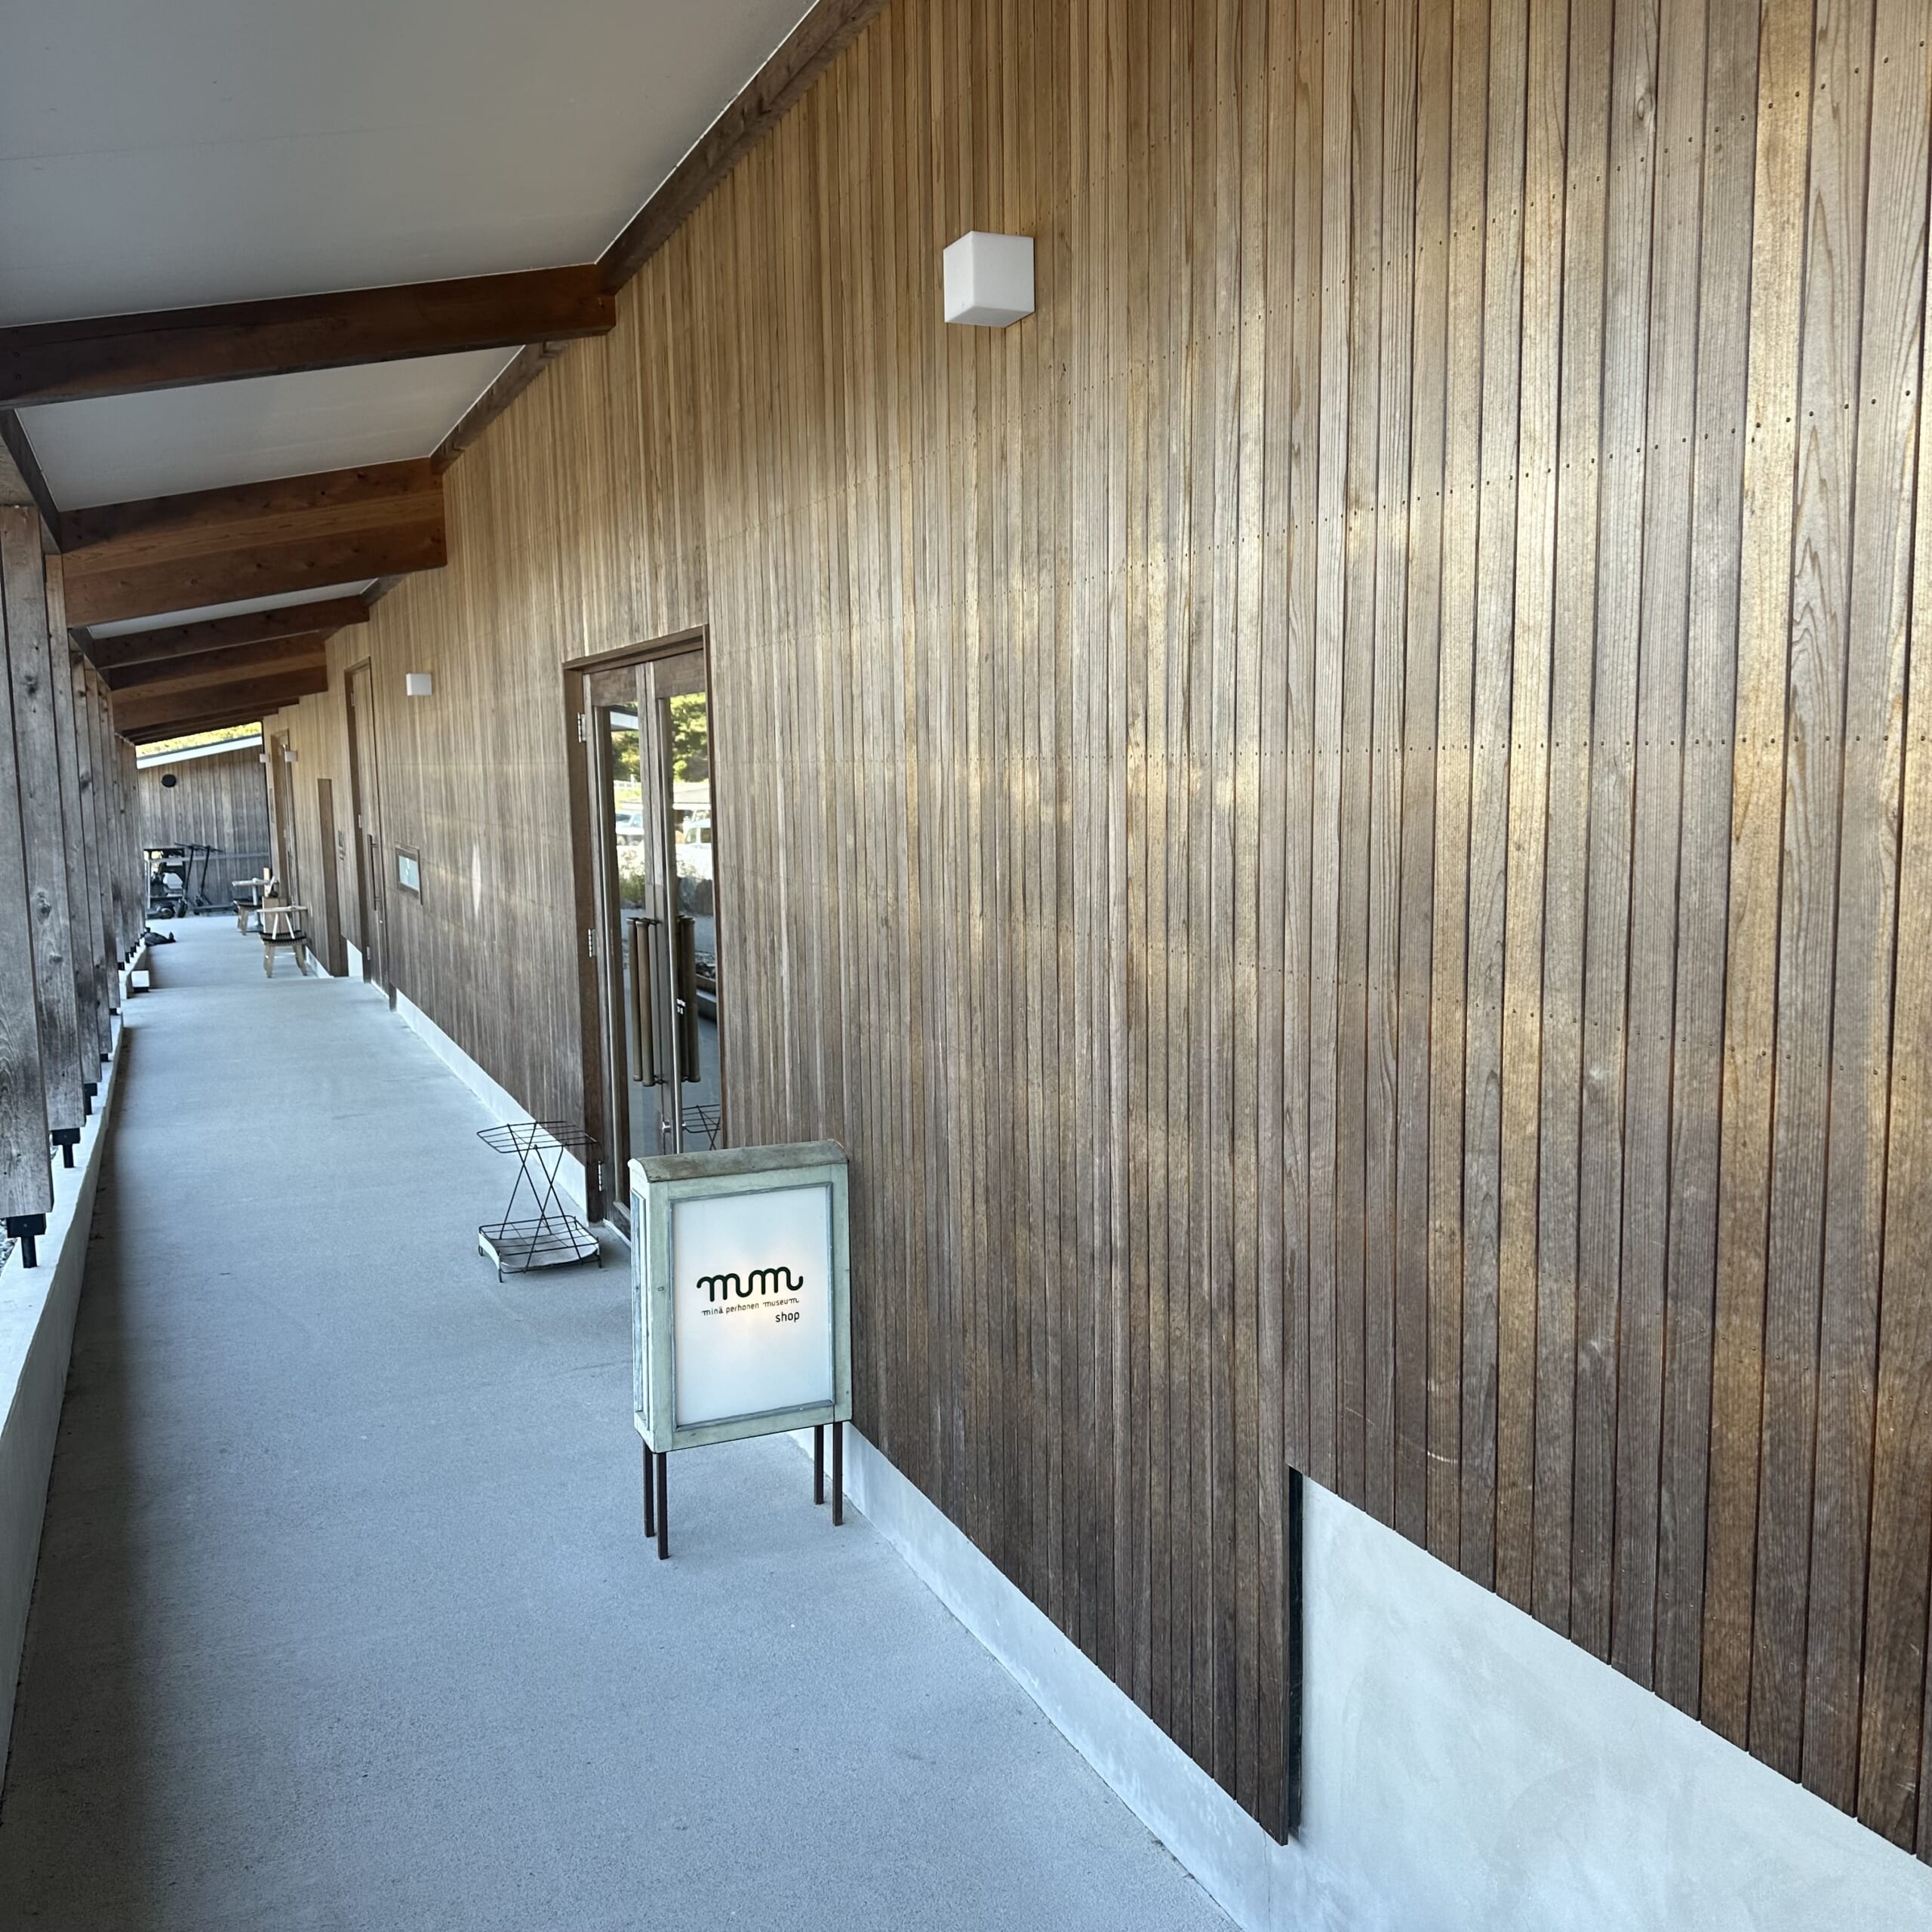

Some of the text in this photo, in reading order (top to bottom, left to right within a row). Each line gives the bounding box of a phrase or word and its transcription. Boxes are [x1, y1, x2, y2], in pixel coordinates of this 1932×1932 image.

[701, 1297, 799, 1316] minä perhonen museum
[775, 1311, 800, 1323] shop
